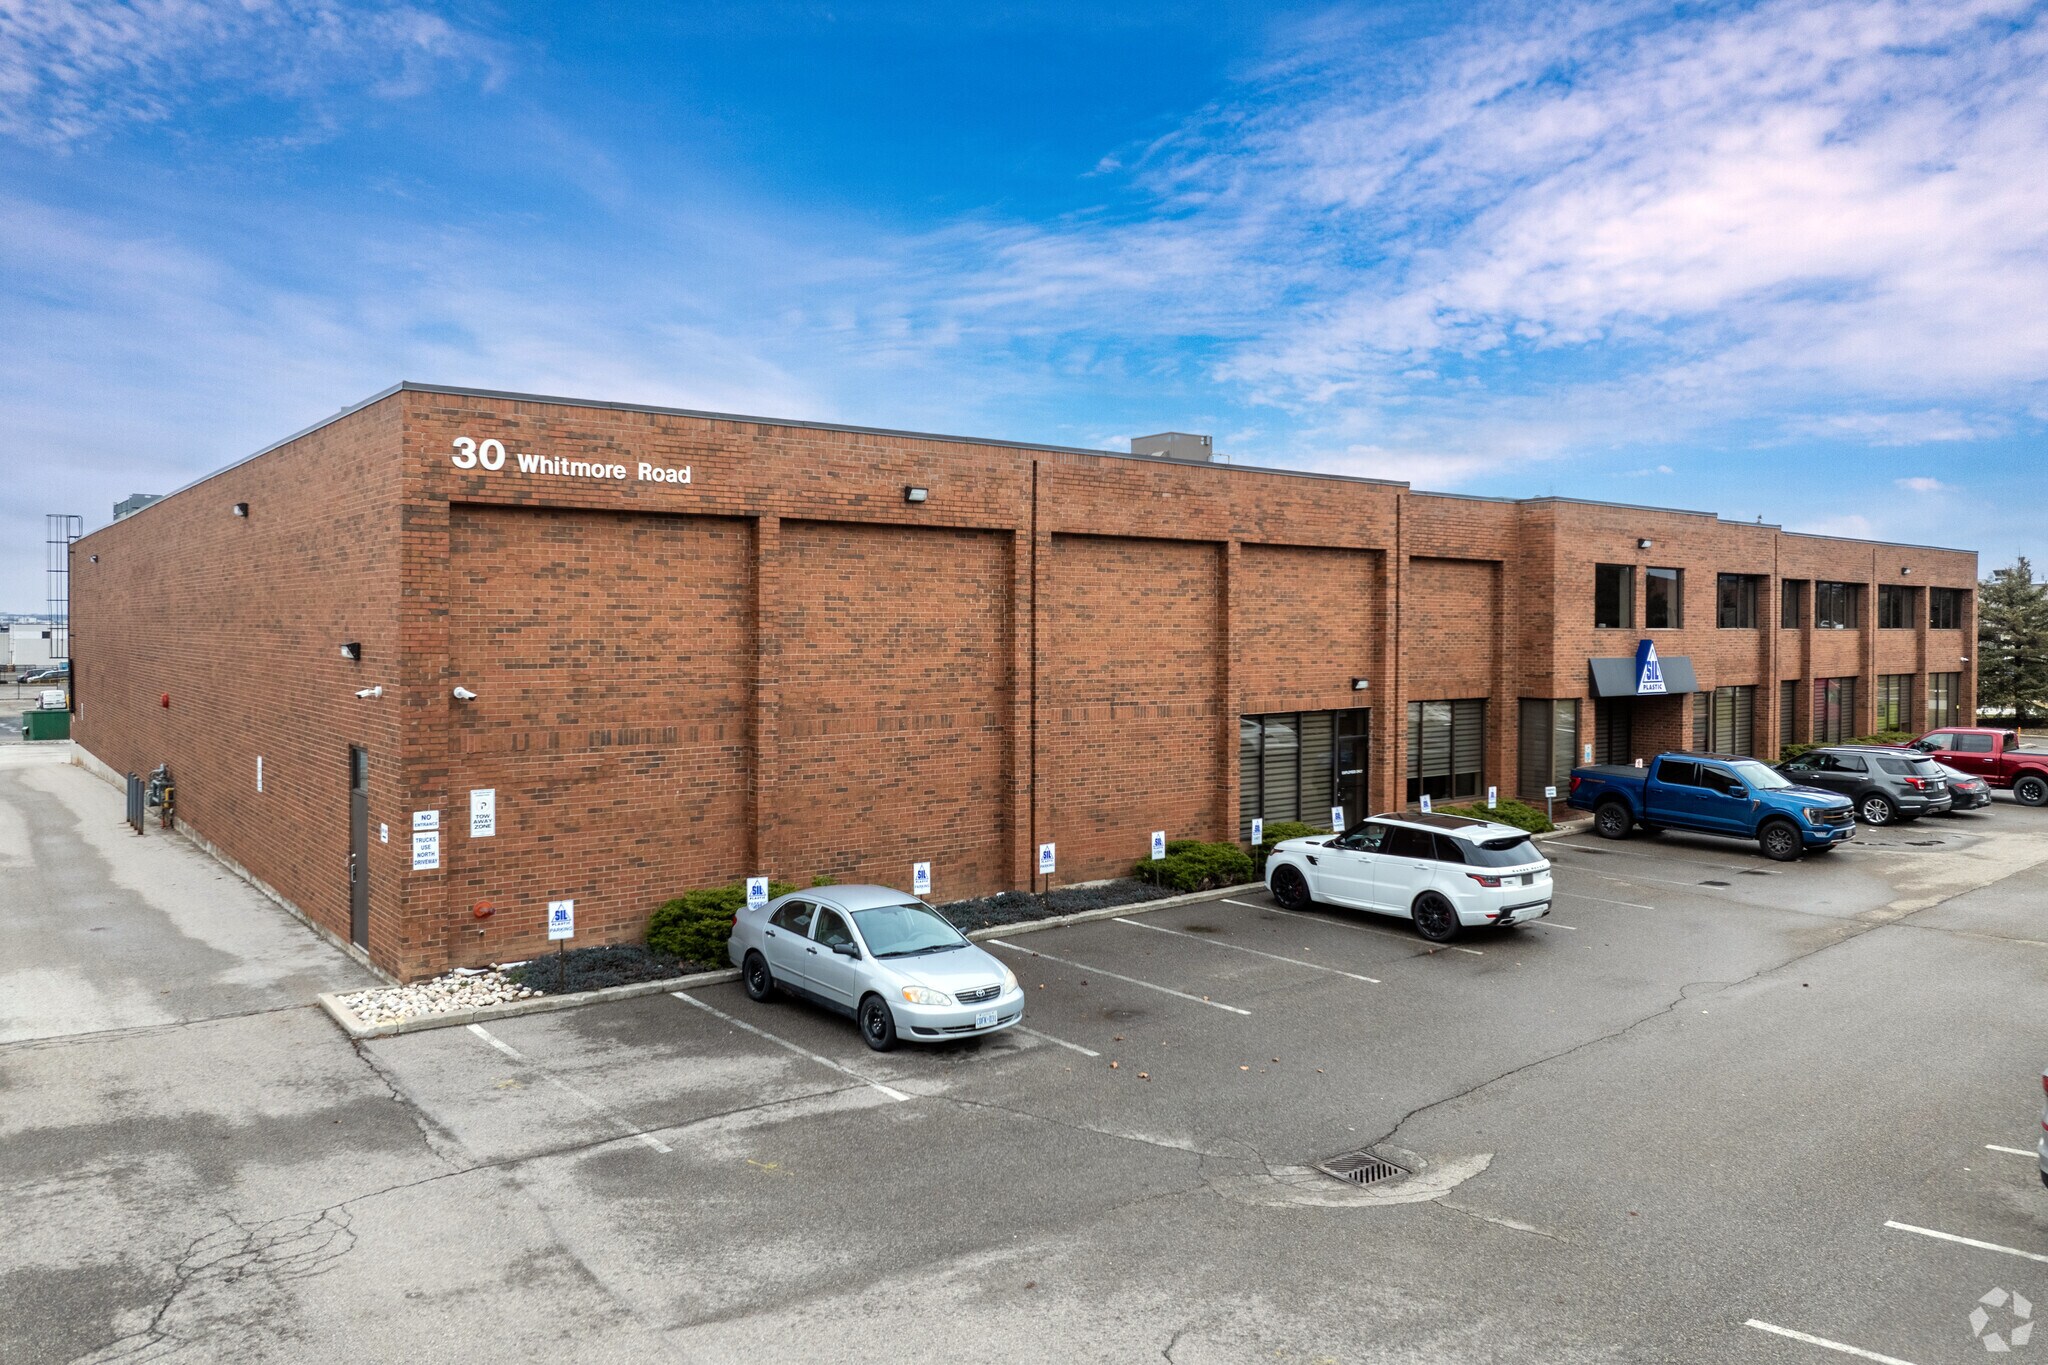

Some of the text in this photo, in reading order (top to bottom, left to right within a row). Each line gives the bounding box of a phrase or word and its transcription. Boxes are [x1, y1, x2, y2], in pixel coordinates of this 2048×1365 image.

[451, 436, 692, 484] 30 Whitmore Road
[1646, 660, 1659, 680] SIL
[1043, 850, 1051, 859] SIL
[414, 858, 438, 866] DRIVEWAY
[917, 870, 926, 879] SIL
[752, 885, 763, 895] SIL
[555, 910, 568, 921] SIL
